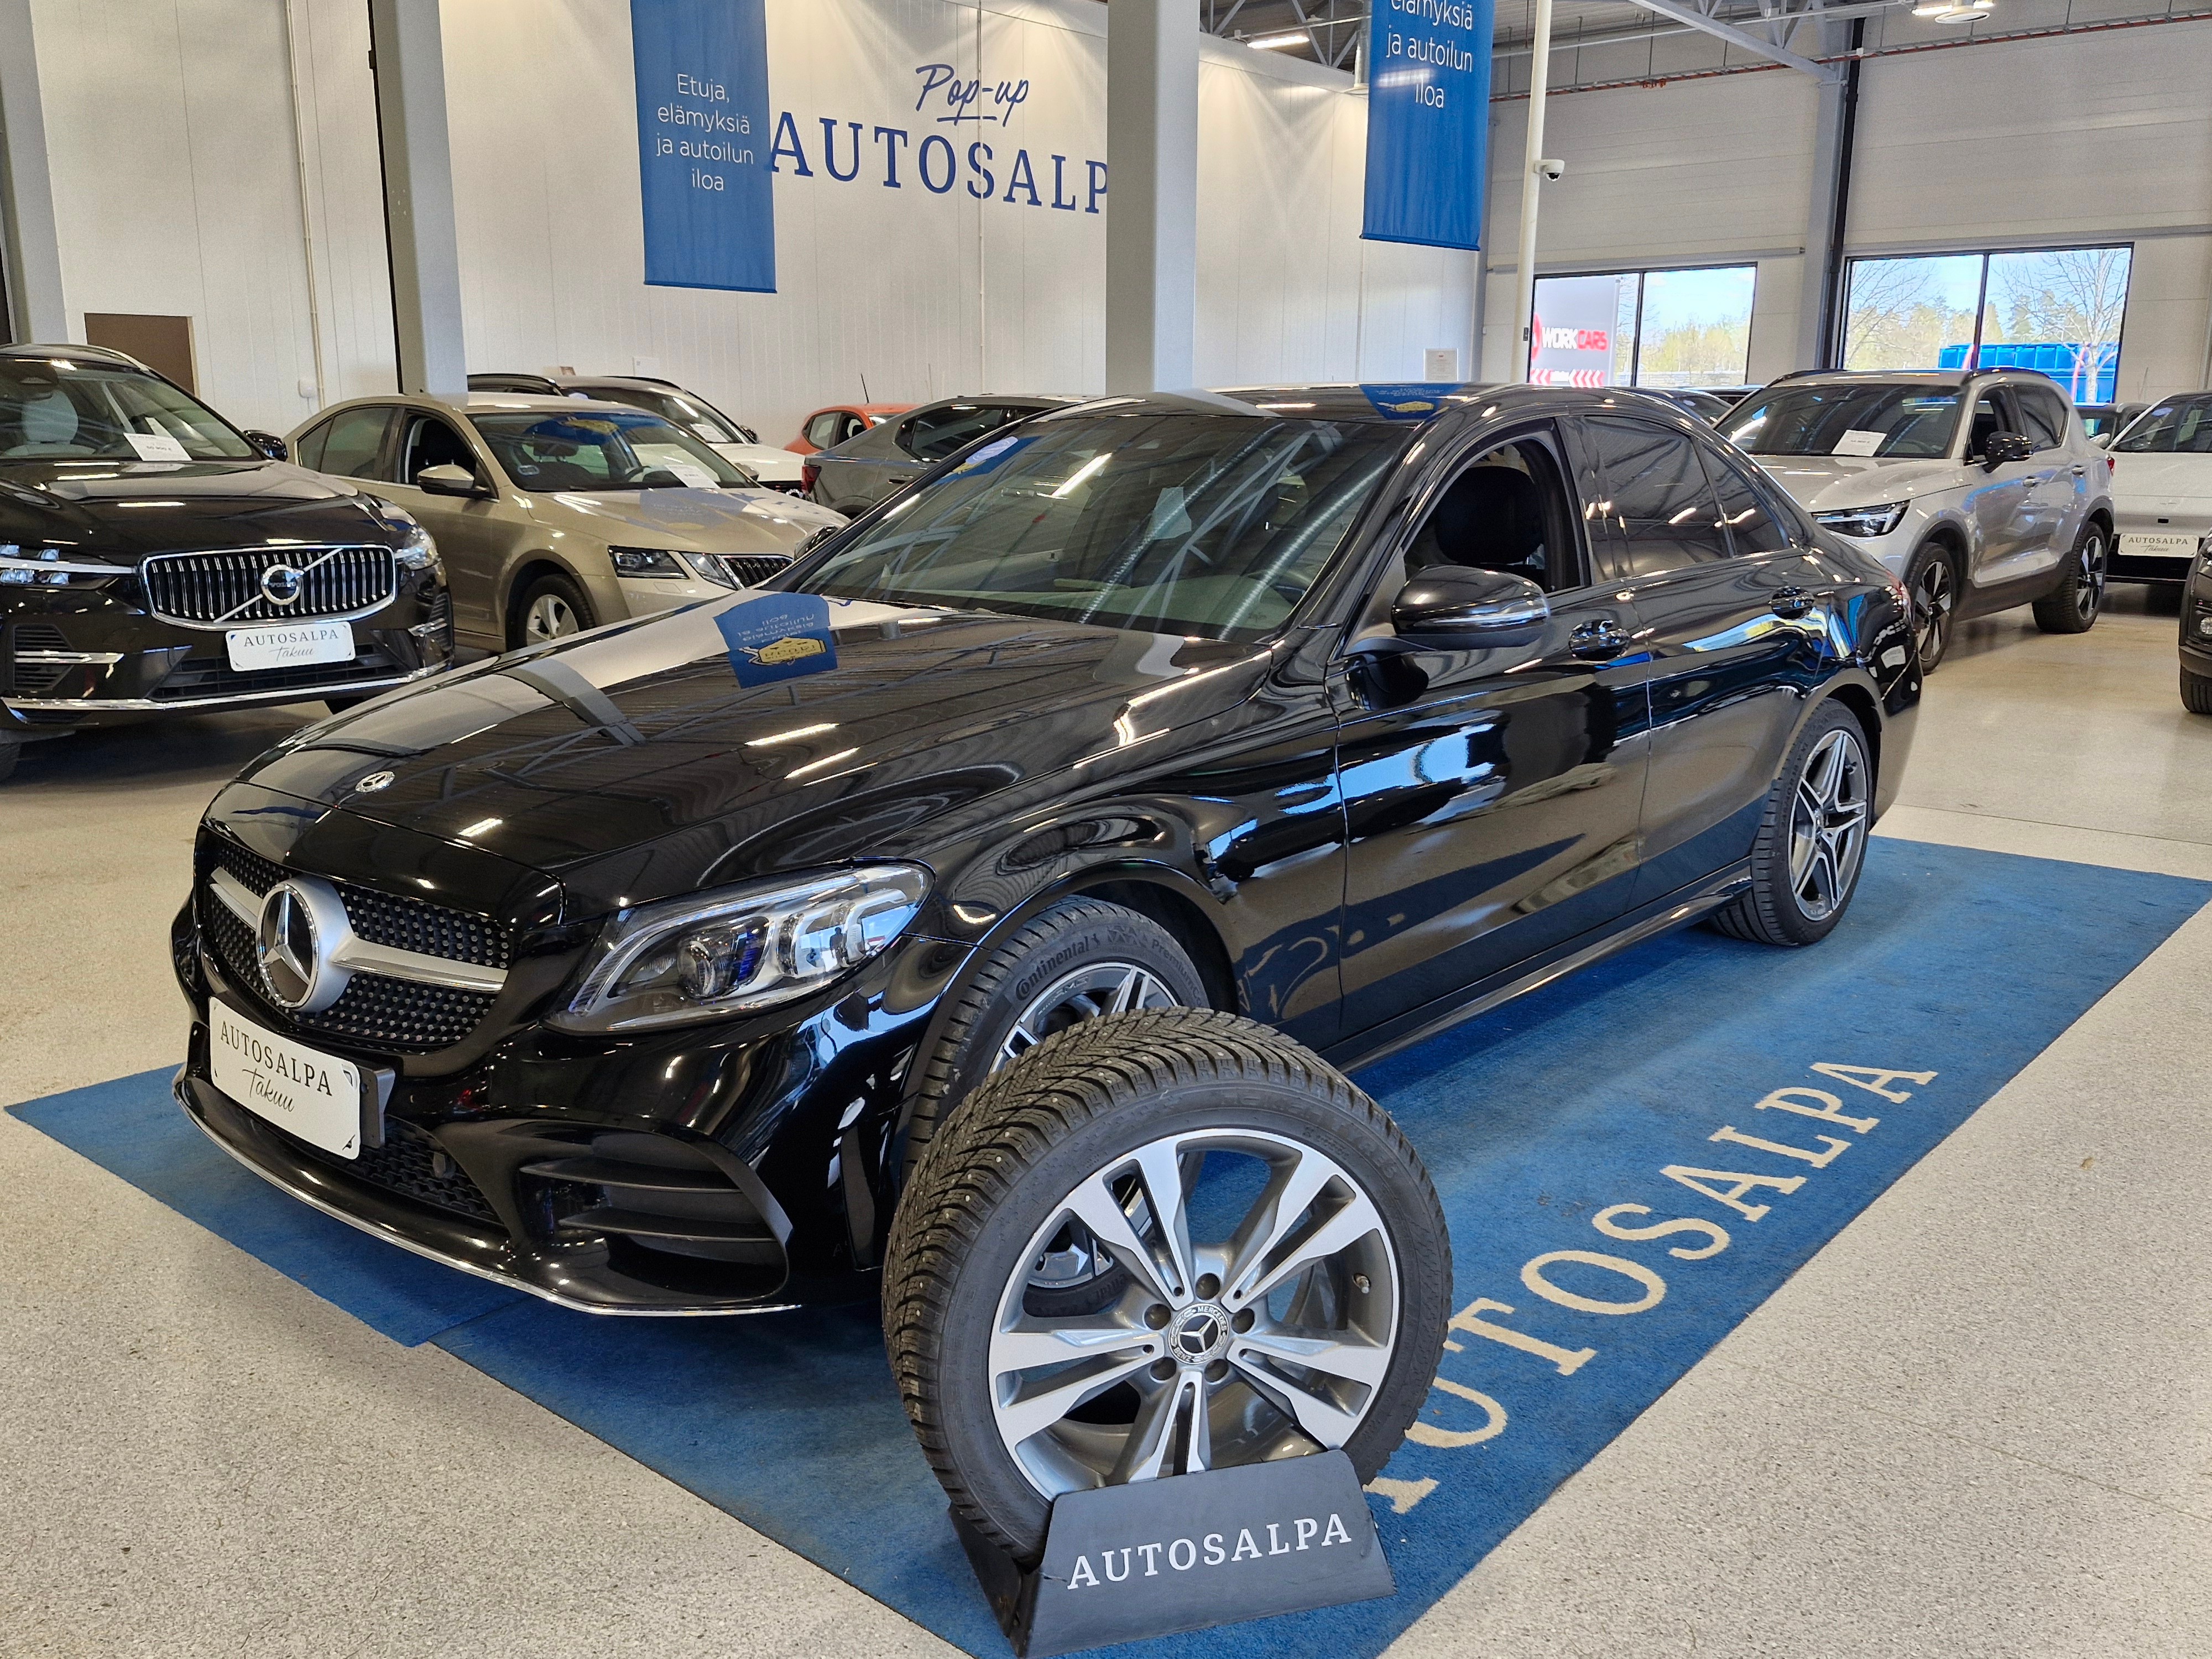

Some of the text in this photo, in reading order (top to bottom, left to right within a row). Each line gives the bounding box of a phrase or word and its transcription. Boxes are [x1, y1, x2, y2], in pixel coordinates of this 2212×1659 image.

[1386, 25, 1473, 72] ja autoilun
[677, 73, 730, 103] Etuja,
[915, 64, 1029, 127] Pop-up
[1415, 74, 1444, 108] iloa
[658, 102, 750, 134] elämyksiä
[656, 132, 754, 165] ja autoilun
[692, 168, 724, 191] iloa
[2128, 537, 2188, 545] AUTOSALPA
[244, 629, 339, 647] AUTOSALPA
[269, 646, 314, 661] Takuu
[1016, 937, 1090, 1000] Continental
[221, 1020, 333, 1097] AUTOSALPA
[242, 1068, 295, 1113] Takuu
[1364, 1062, 1939, 1515] UTOSALPA
[1197, 1306, 1227, 1332] MERCEDES
[1174, 1347, 1193, 1361] BENZ
[1067, 1514, 1352, 1590] AUTOSALPA
